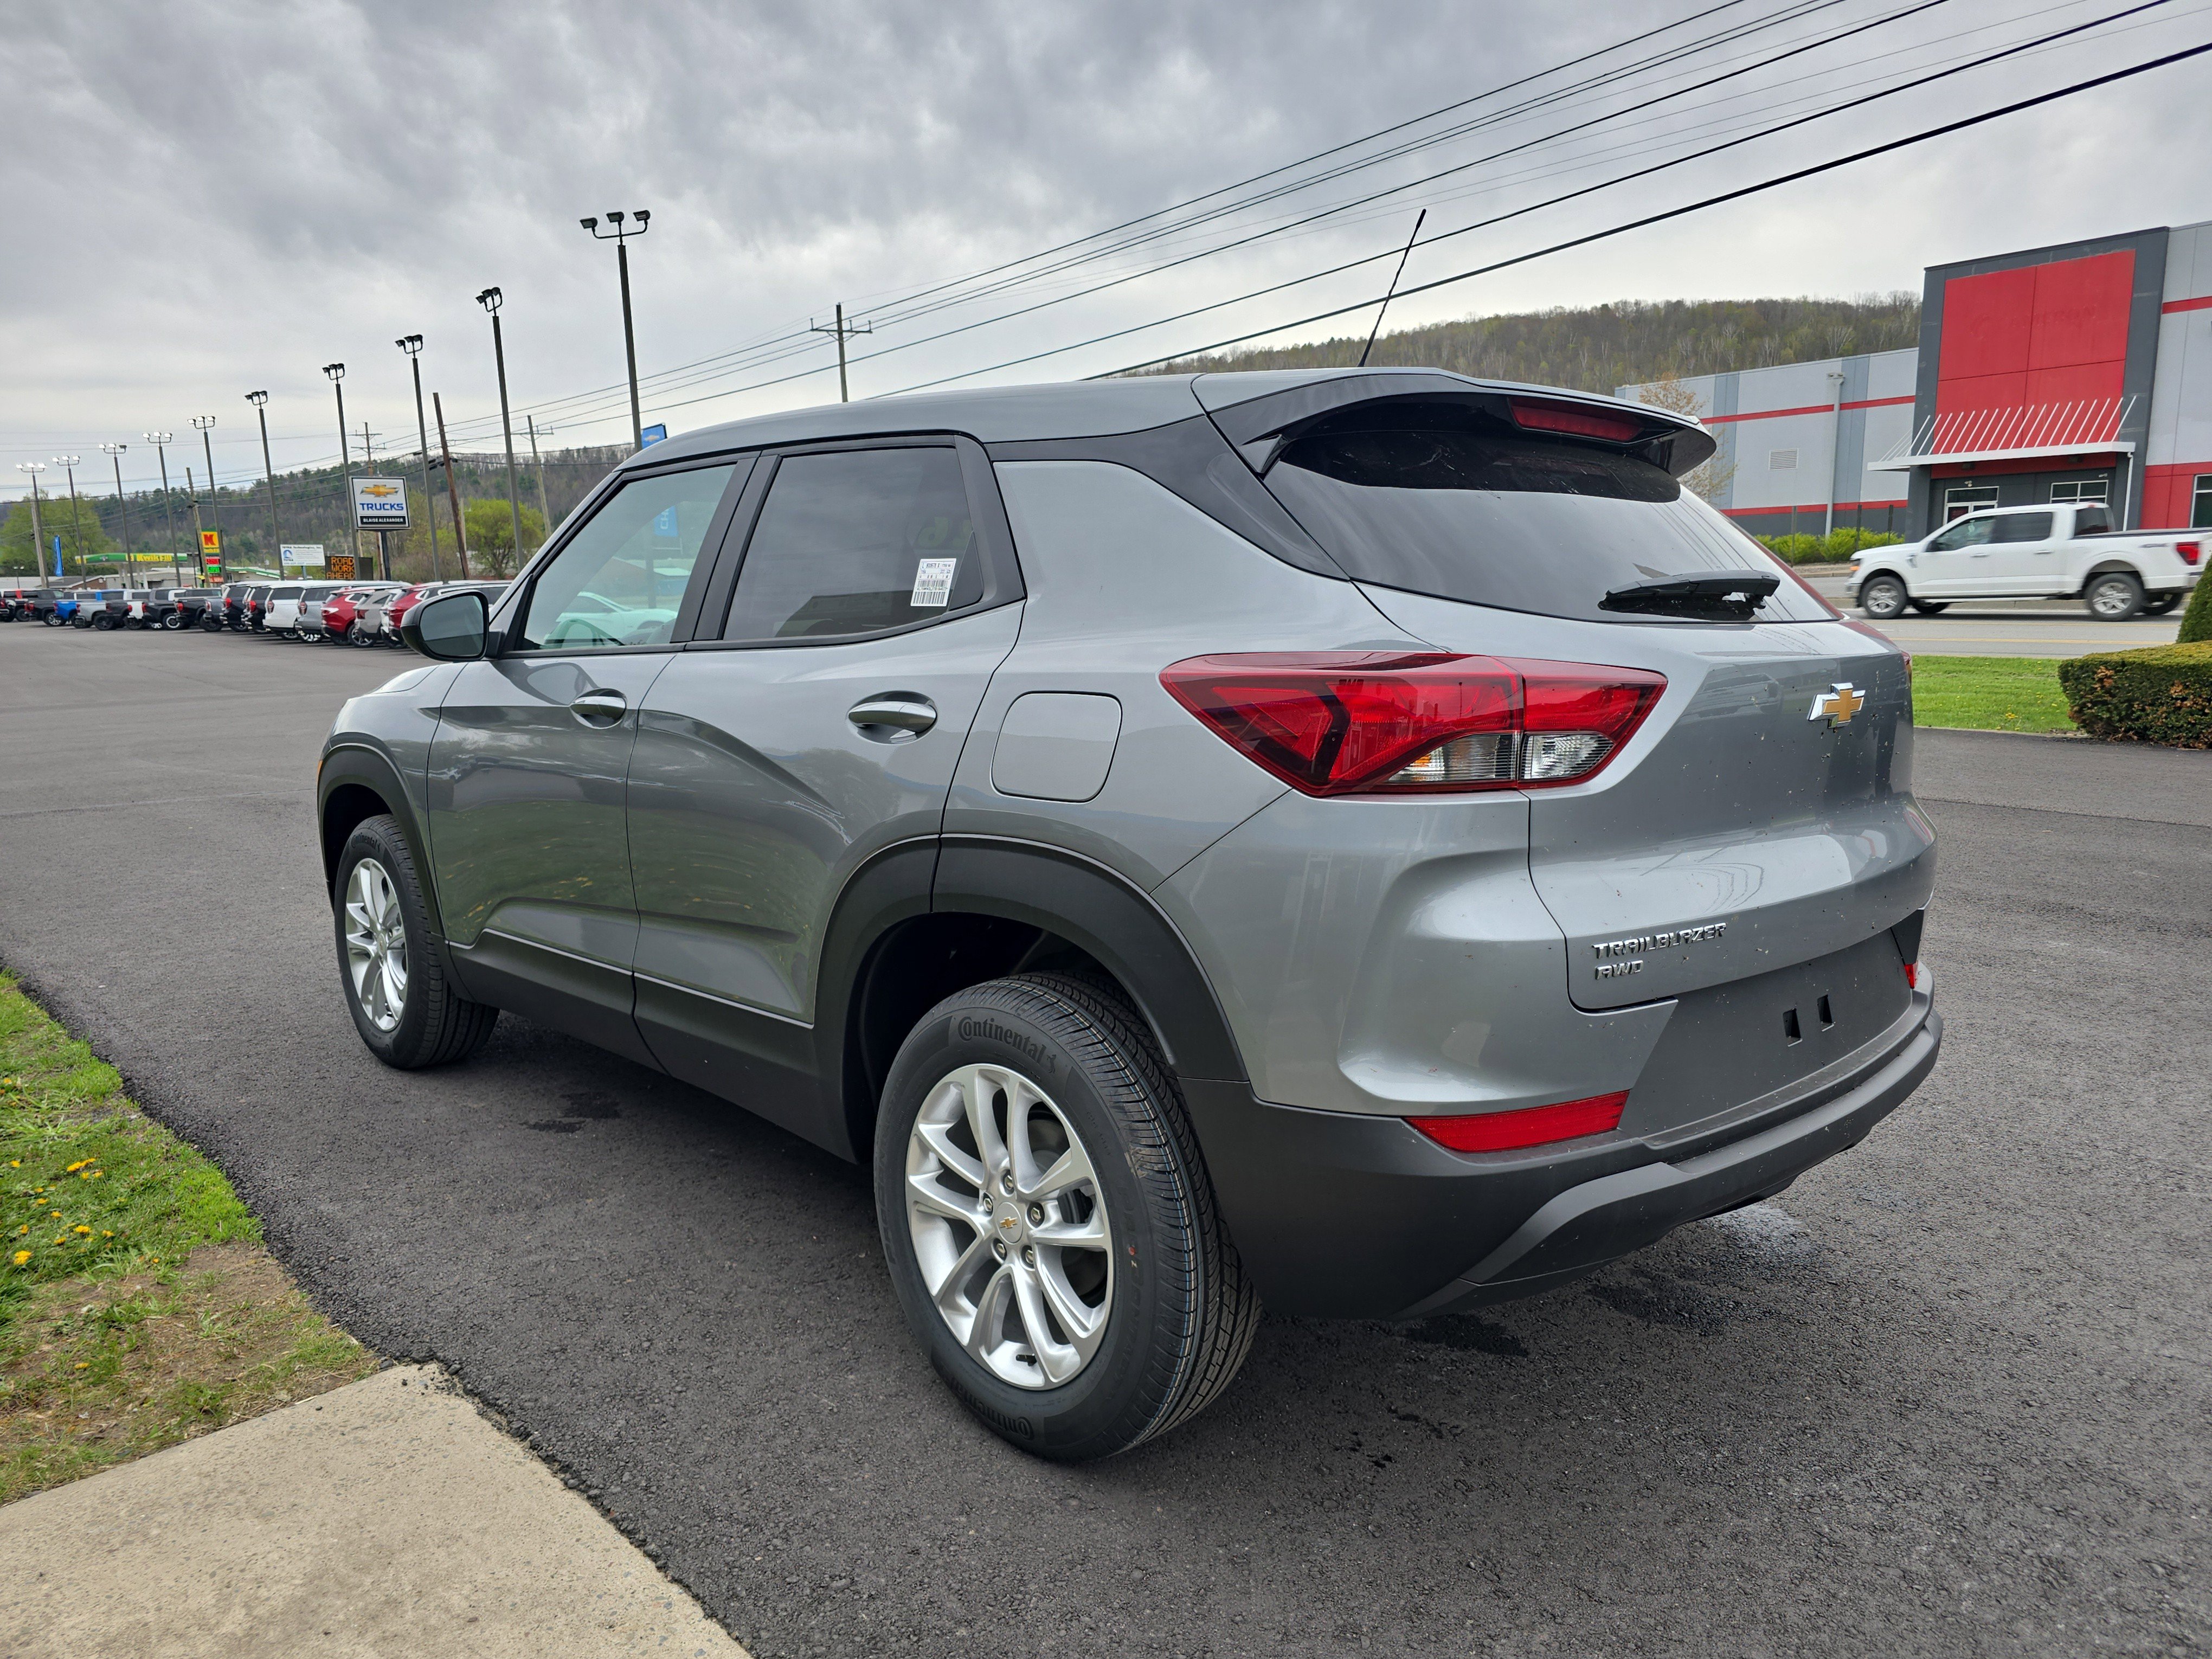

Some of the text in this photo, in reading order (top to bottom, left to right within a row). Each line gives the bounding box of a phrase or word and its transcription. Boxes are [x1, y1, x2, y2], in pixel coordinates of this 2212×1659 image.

[359, 503, 404, 511] TRUCKS
[203, 534, 216, 545] K
[331, 557, 354, 565] ROAD
[332, 565, 355, 573] WORK
[351, 832, 378, 850] Continental
[1592, 923, 1727, 959] TRAILBLAZER
[1595, 960, 1643, 980] AWD
[958, 1016, 1046, 1064] Continental
